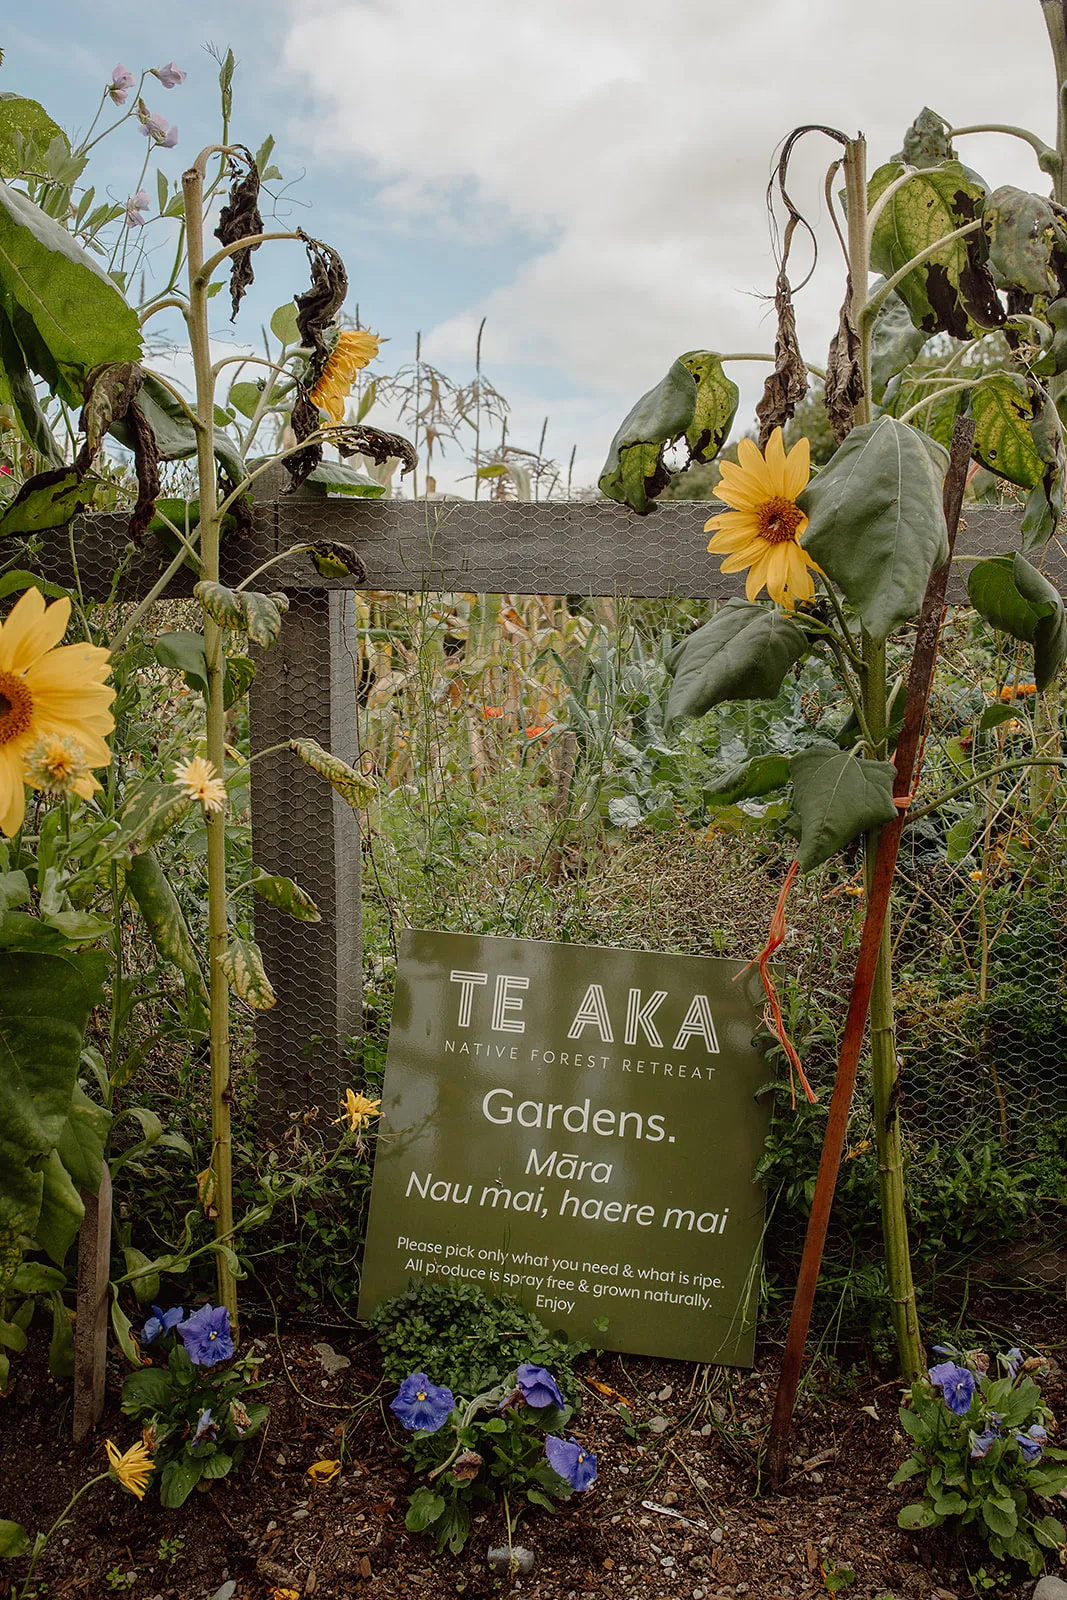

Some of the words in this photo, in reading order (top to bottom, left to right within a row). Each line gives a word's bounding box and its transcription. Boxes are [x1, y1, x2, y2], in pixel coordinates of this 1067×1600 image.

[450, 970, 530, 1034] TE
[567, 984, 721, 1054] AKA
[445, 1040, 518, 1060] NATIVE
[531, 1049, 610, 1069] FOREST
[622, 1059, 716, 1080] RETREAT
[482, 1088, 676, 1143] Gardens.
[525, 1148, 613, 1184] Māra
[405, 1171, 472, 1204] Nau
[480, 1185, 548, 1219] mai,
[559, 1189, 655, 1226] haere
[663, 1206, 730, 1235] mai
[397, 1236, 442, 1253] Please
[445, 1244, 474, 1258] pick
[478, 1249, 508, 1265] only
[511, 1252, 549, 1266] what
[552, 1257, 578, 1271] you
[582, 1261, 619, 1275] need
[622, 1264, 634, 1277] &
[637, 1267, 675, 1282] what
[679, 1271, 690, 1284] is
[693, 1273, 725, 1290] ripe.
[404, 1258, 422, 1272] All
[425, 1263, 486, 1280] produce
[489, 1267, 500, 1281] is
[503, 1272, 544, 1289] spray
[547, 1275, 575, 1290] free
[578, 1279, 589, 1292] &
[592, 1283, 640, 1298] grown
[644, 1288, 713, 1310] naturally.
[536, 1294, 575, 1314] Enjoy
